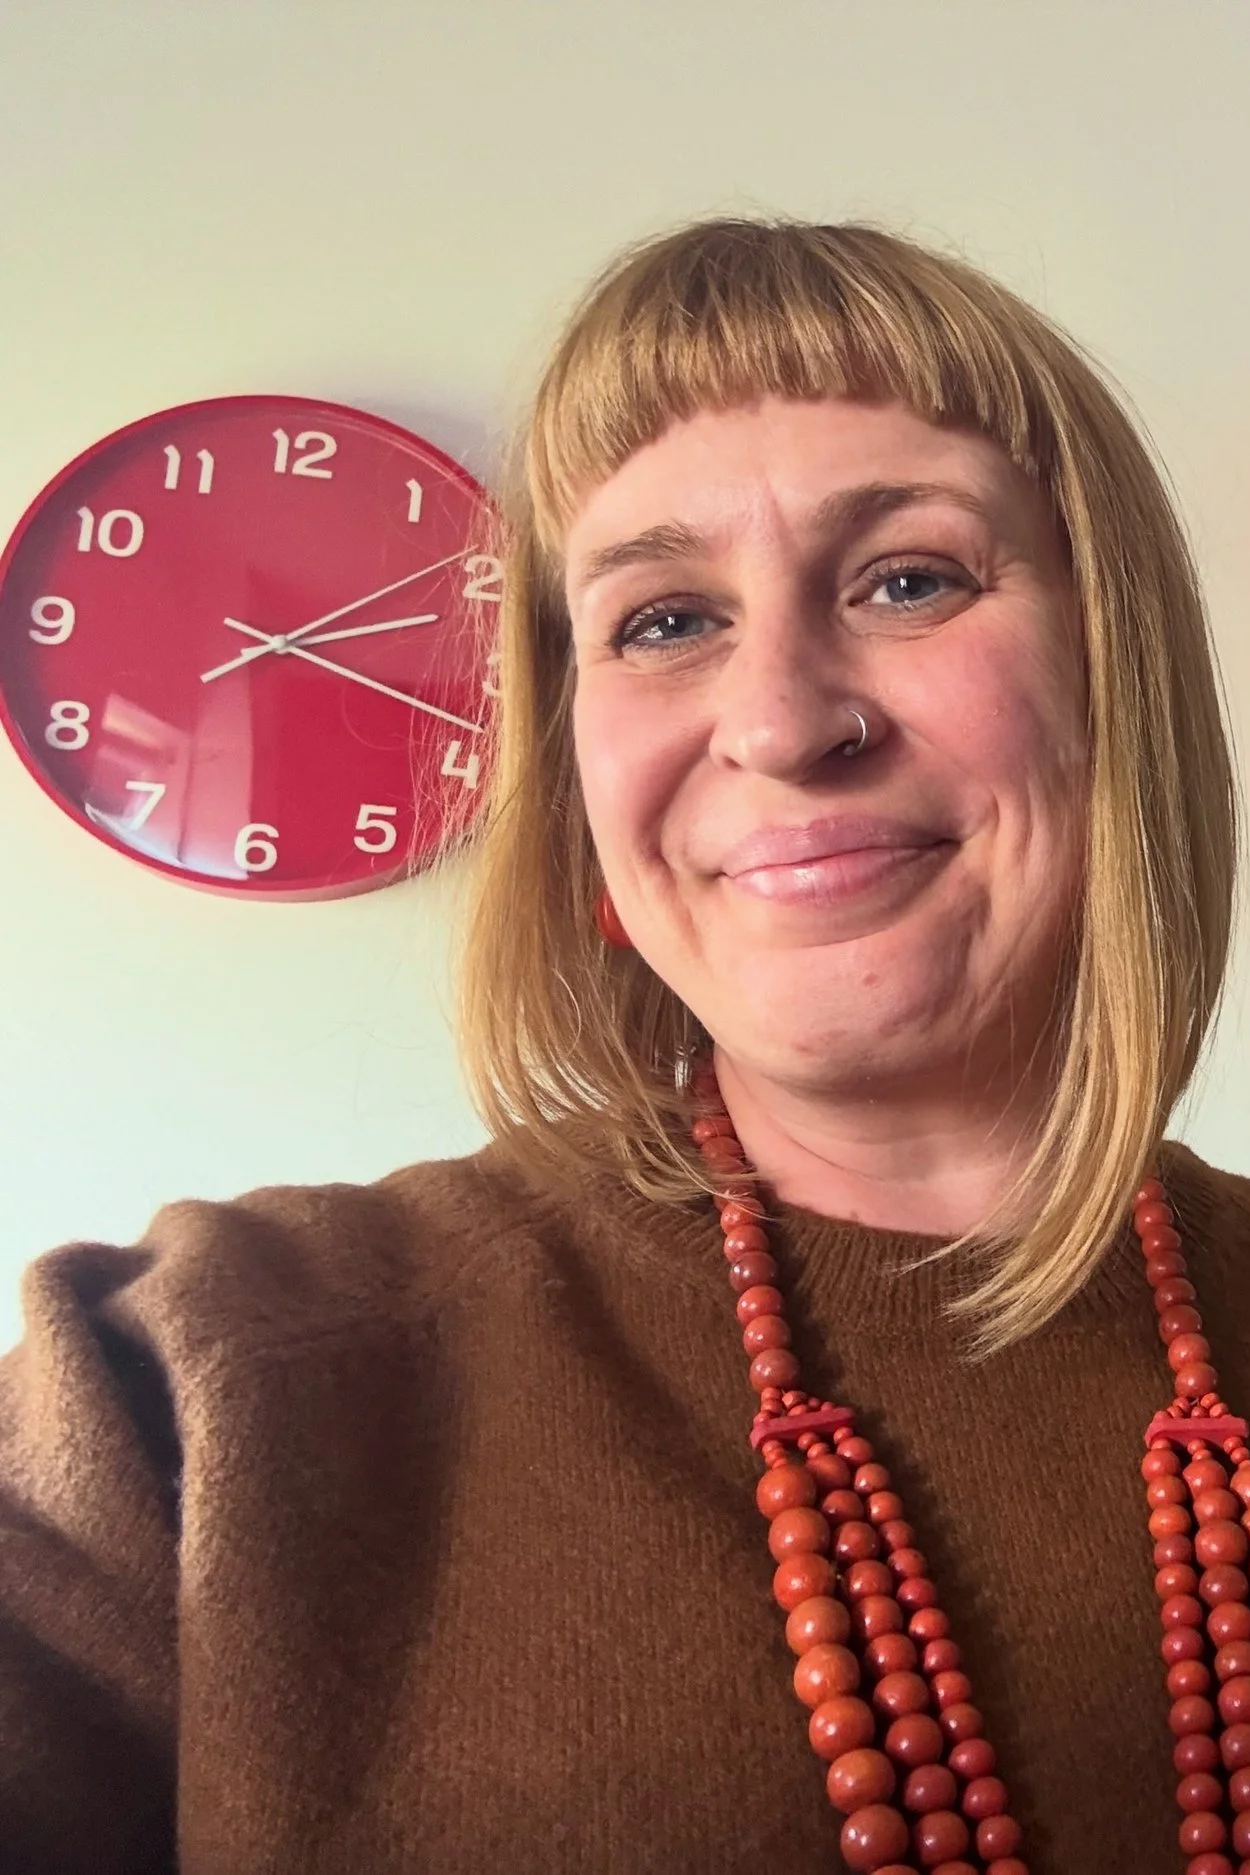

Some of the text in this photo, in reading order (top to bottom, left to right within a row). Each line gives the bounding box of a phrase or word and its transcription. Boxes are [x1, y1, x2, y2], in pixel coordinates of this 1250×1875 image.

[163, 444, 214, 494] 11
[273, 428, 337, 479] 12
[405, 478, 423, 523] 1
[77, 506, 144, 557] 10
[462, 554, 505, 602] 2
[29, 596, 75, 646] 9
[44, 700, 90, 751] 8
[440, 740, 480, 789] 4
[125, 780, 166, 833] 7
[353, 803, 398, 854] 5
[233, 823, 280, 872] 6
